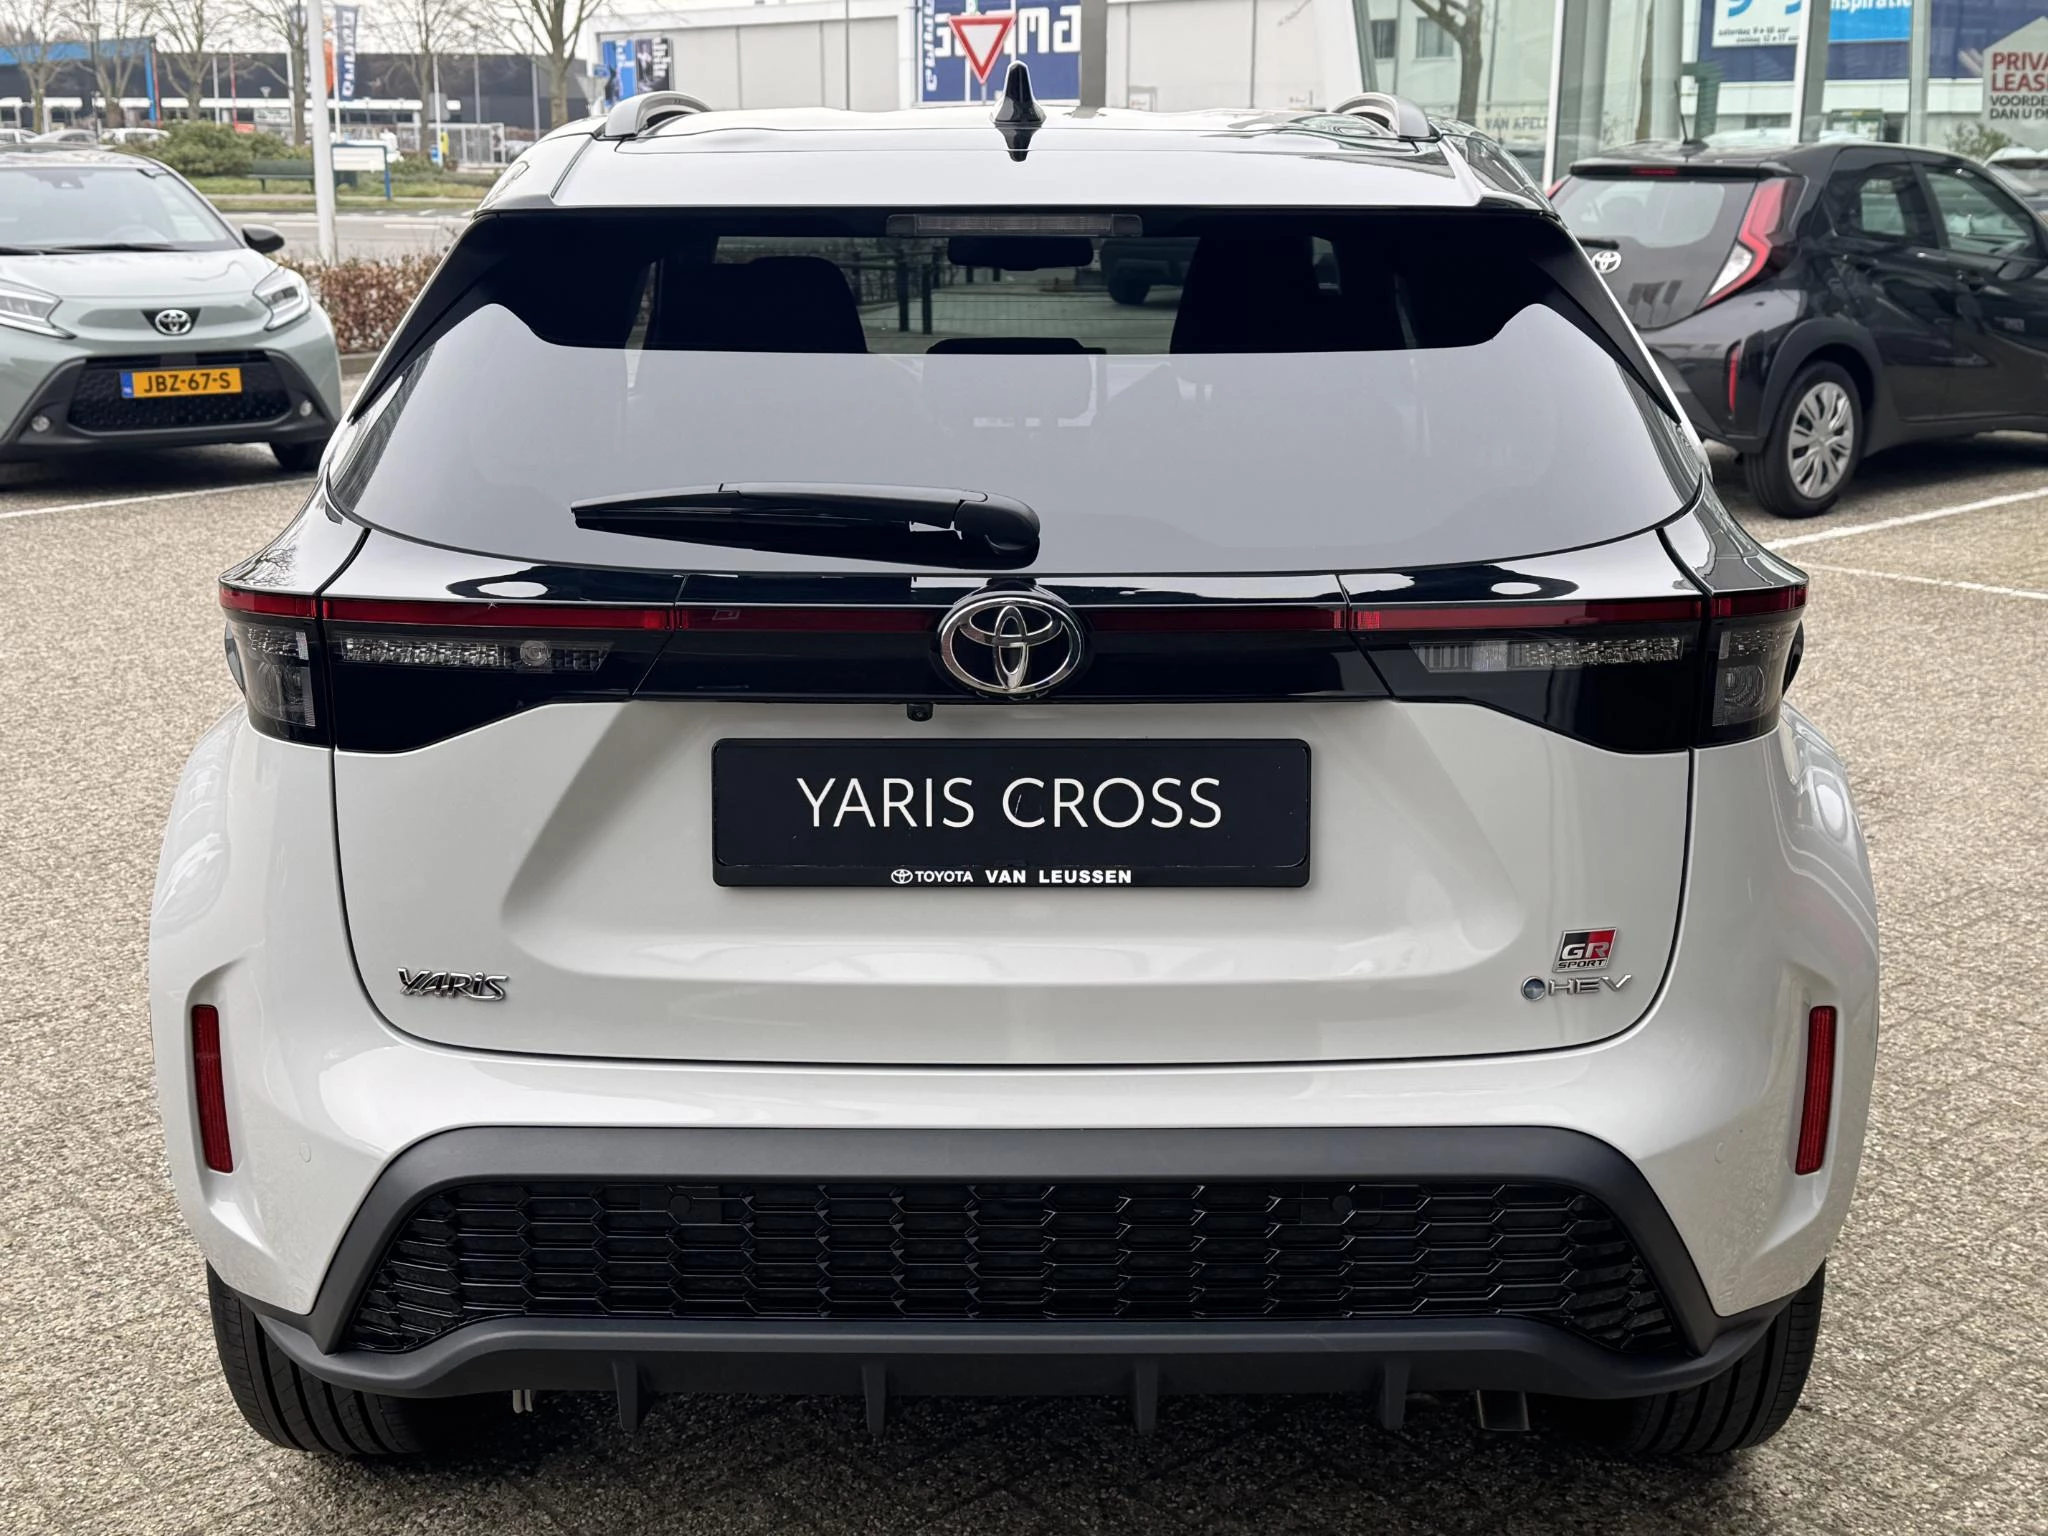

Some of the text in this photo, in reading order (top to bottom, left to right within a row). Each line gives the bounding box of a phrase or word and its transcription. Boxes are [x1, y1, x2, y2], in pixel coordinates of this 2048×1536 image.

[1992, 73, 2048, 91] LEAS
[1990, 108, 2048, 119] DAN U D
[1485, 117, 1509, 130] VAN
[144, 372, 231, 393] JBZ-67-S
[797, 777, 1222, 828] YARIS CROSS
[915, 870, 1132, 883] TOYOTA VAN LEUSSEN
[1562, 944, 1609, 959] GR
[1558, 959, 1606, 968] SPORT
[1548, 974, 1632, 996] HEV
